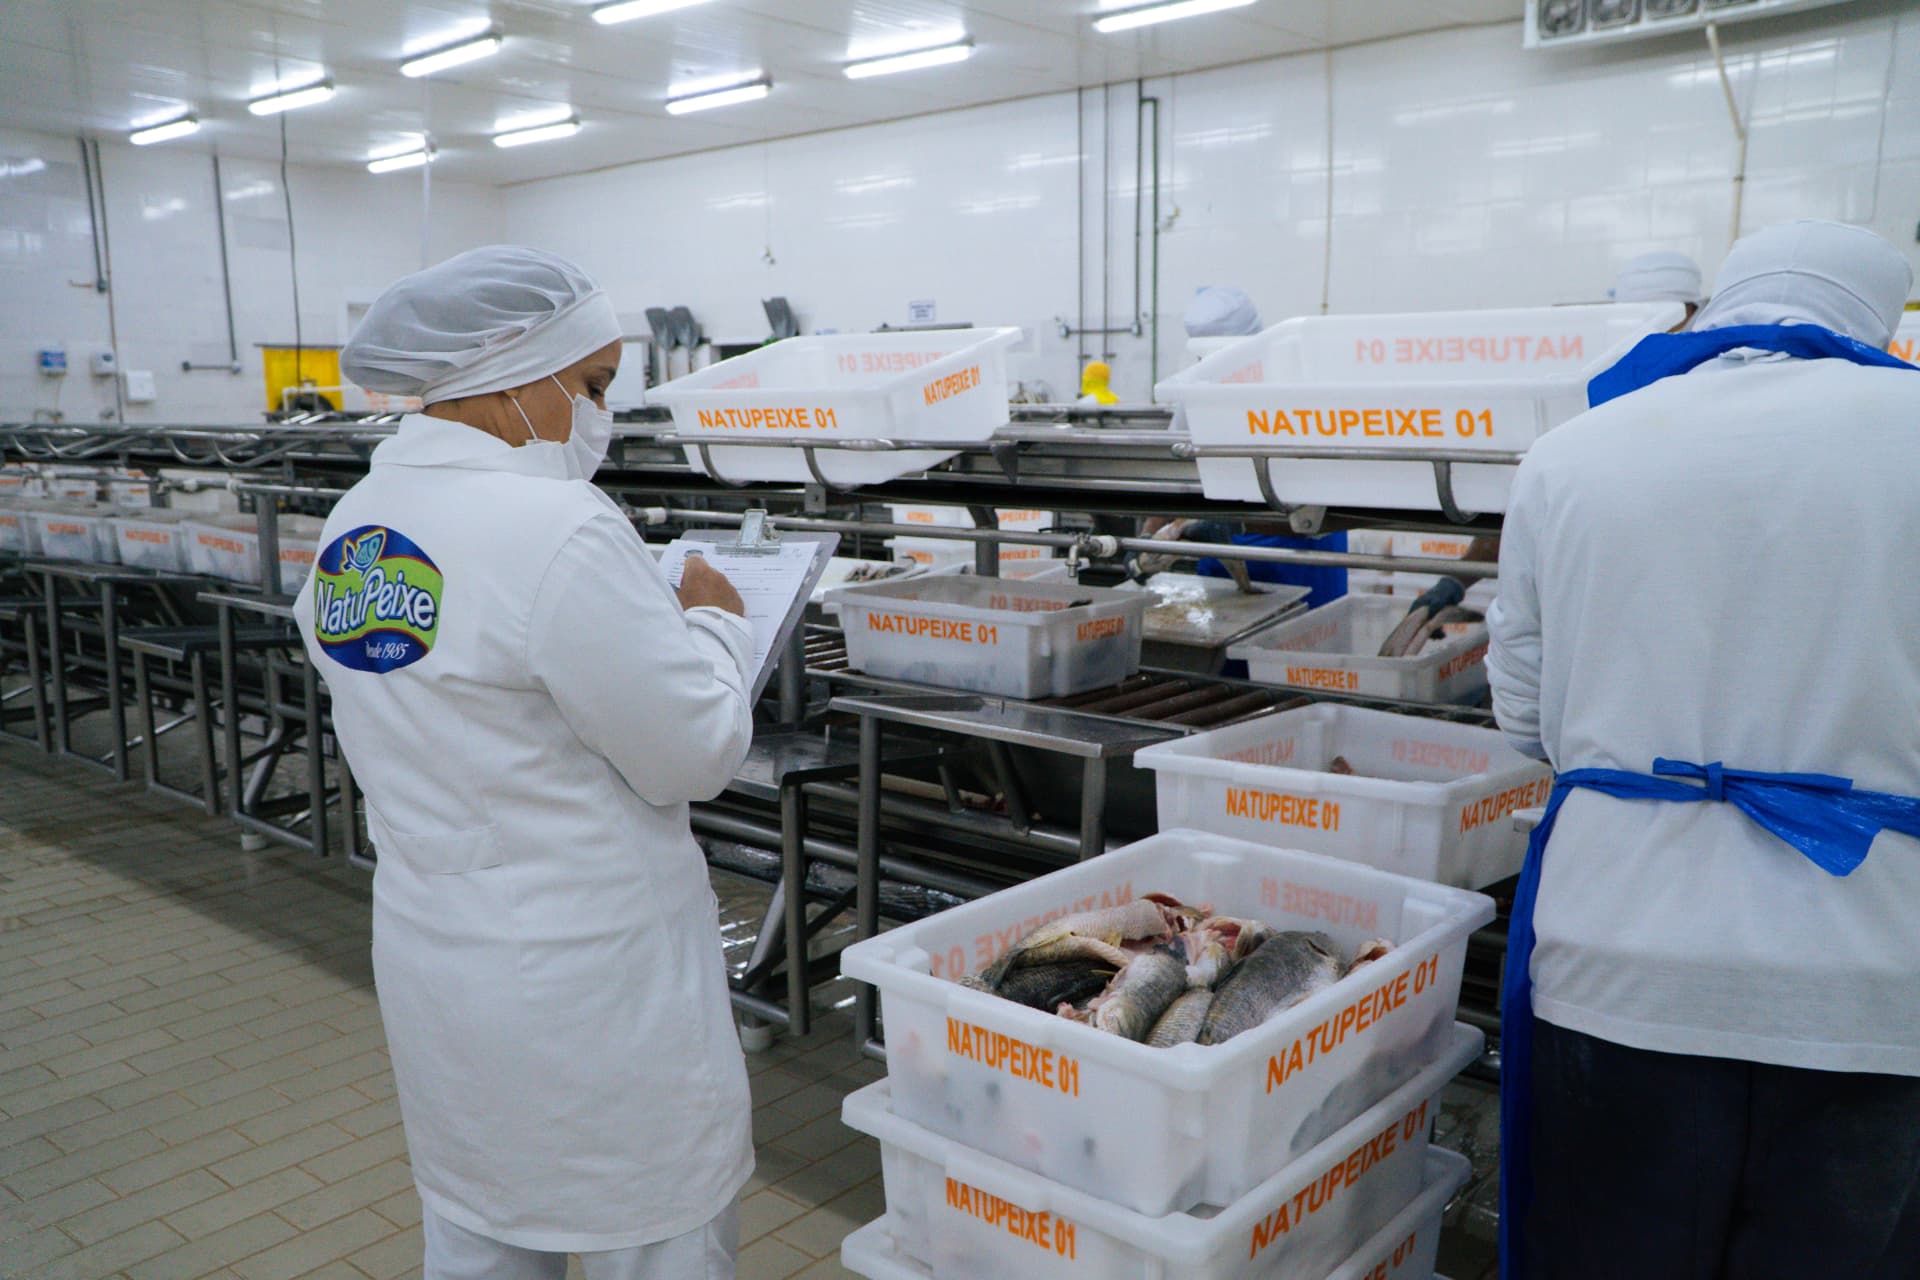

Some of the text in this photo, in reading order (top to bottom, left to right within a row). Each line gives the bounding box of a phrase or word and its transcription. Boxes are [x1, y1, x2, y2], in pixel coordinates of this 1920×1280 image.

[923, 369, 970, 406] NATUPEIXE
[698, 408, 837, 428] NATUPEIXE 01
[1248, 409, 1493, 437] NATUPEIXE 01
[315, 566, 437, 635] NatuPeixe
[382, 642, 409, 660] 1985
[868, 613, 998, 645] NATUPEIXE 01
[1287, 667, 1358, 690] NATUPEIXE 01
[1226, 787, 1340, 832] NATUPEIXE 01
[1460, 775, 1551, 833] NATUPEIXE 01
[1266, 953, 1438, 1095] NATUPEIXE 01
[946, 1016, 1079, 1098] NATUPEIXE 01
[1250, 1099, 1428, 1261] NATUPEIXE 01
[945, 1176, 1076, 1261] NATUPEIXE 01
